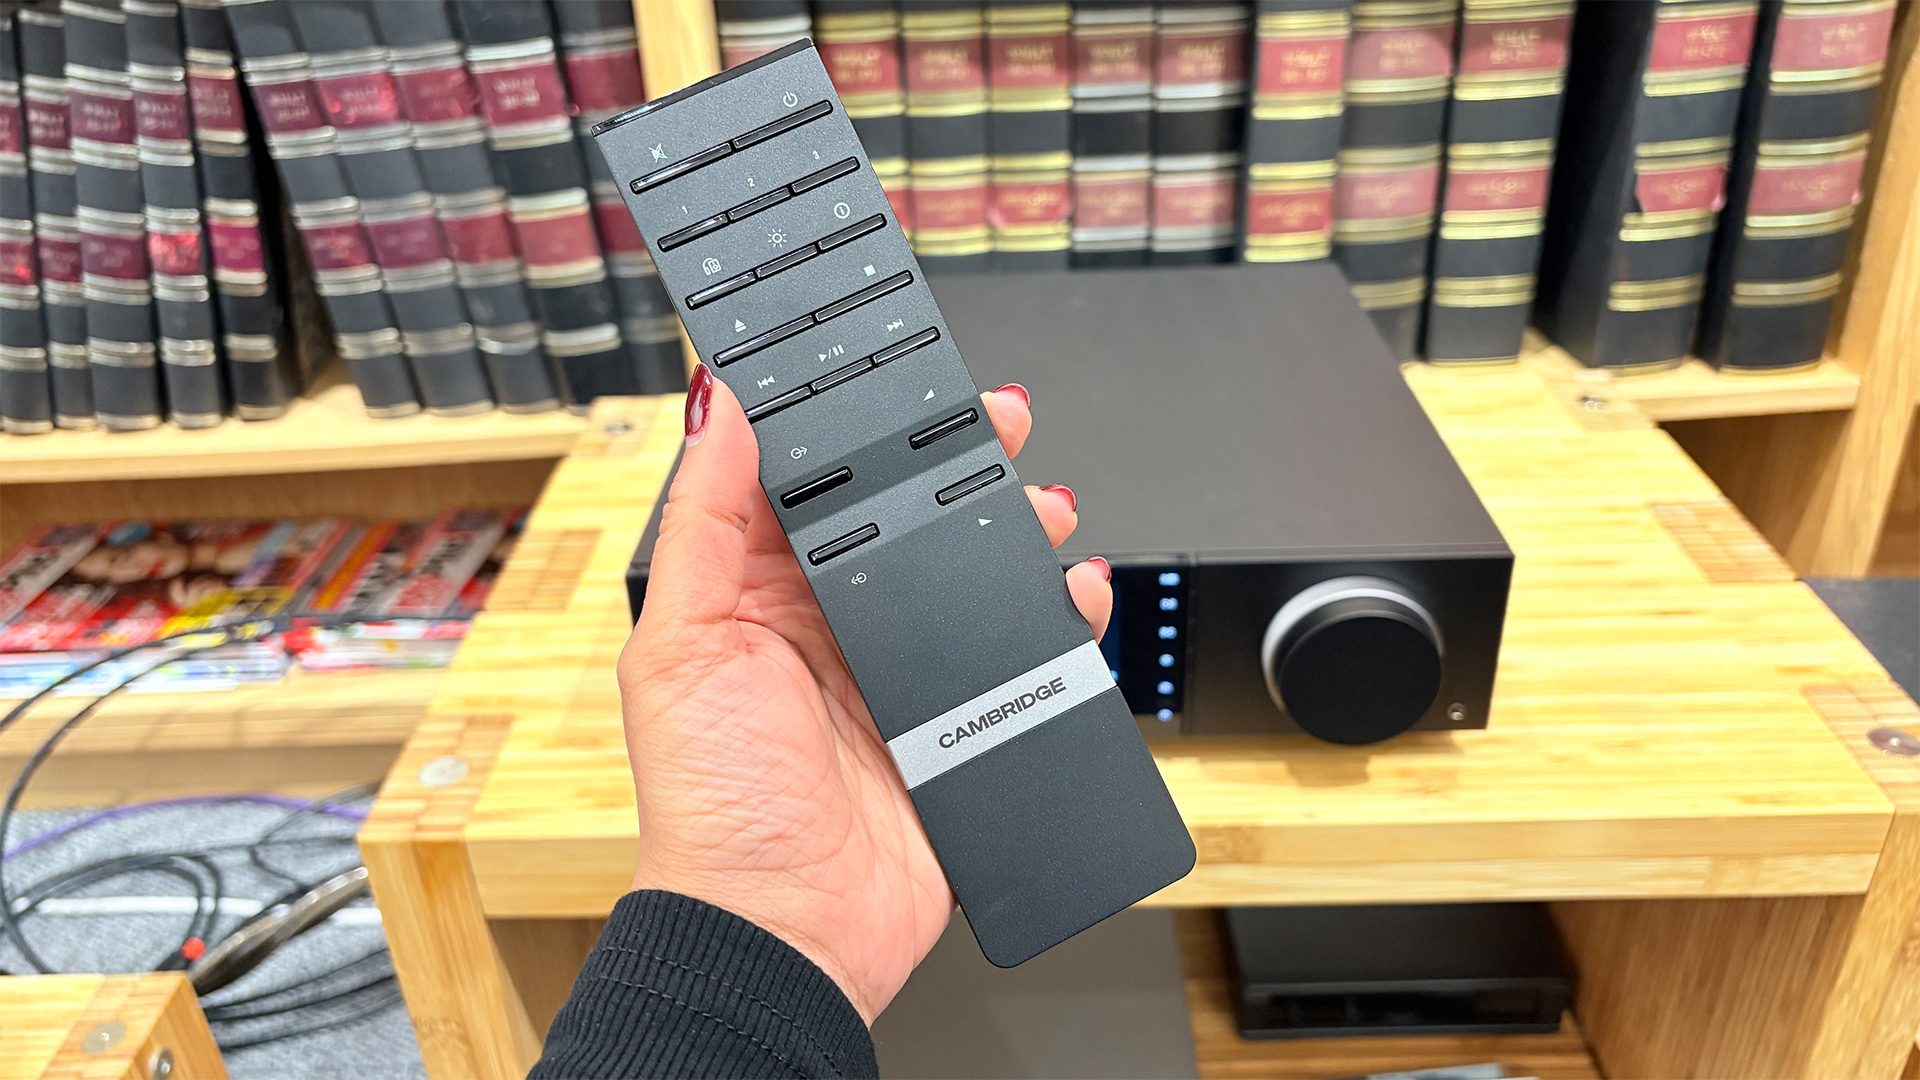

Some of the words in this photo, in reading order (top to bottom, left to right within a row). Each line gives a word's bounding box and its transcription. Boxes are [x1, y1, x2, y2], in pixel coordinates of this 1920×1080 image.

[812, 150, 820, 160] 3
[747, 177, 756, 188] 2
[681, 205, 689, 216] 1
[938, 676, 1067, 749] CAMBRIDGE
